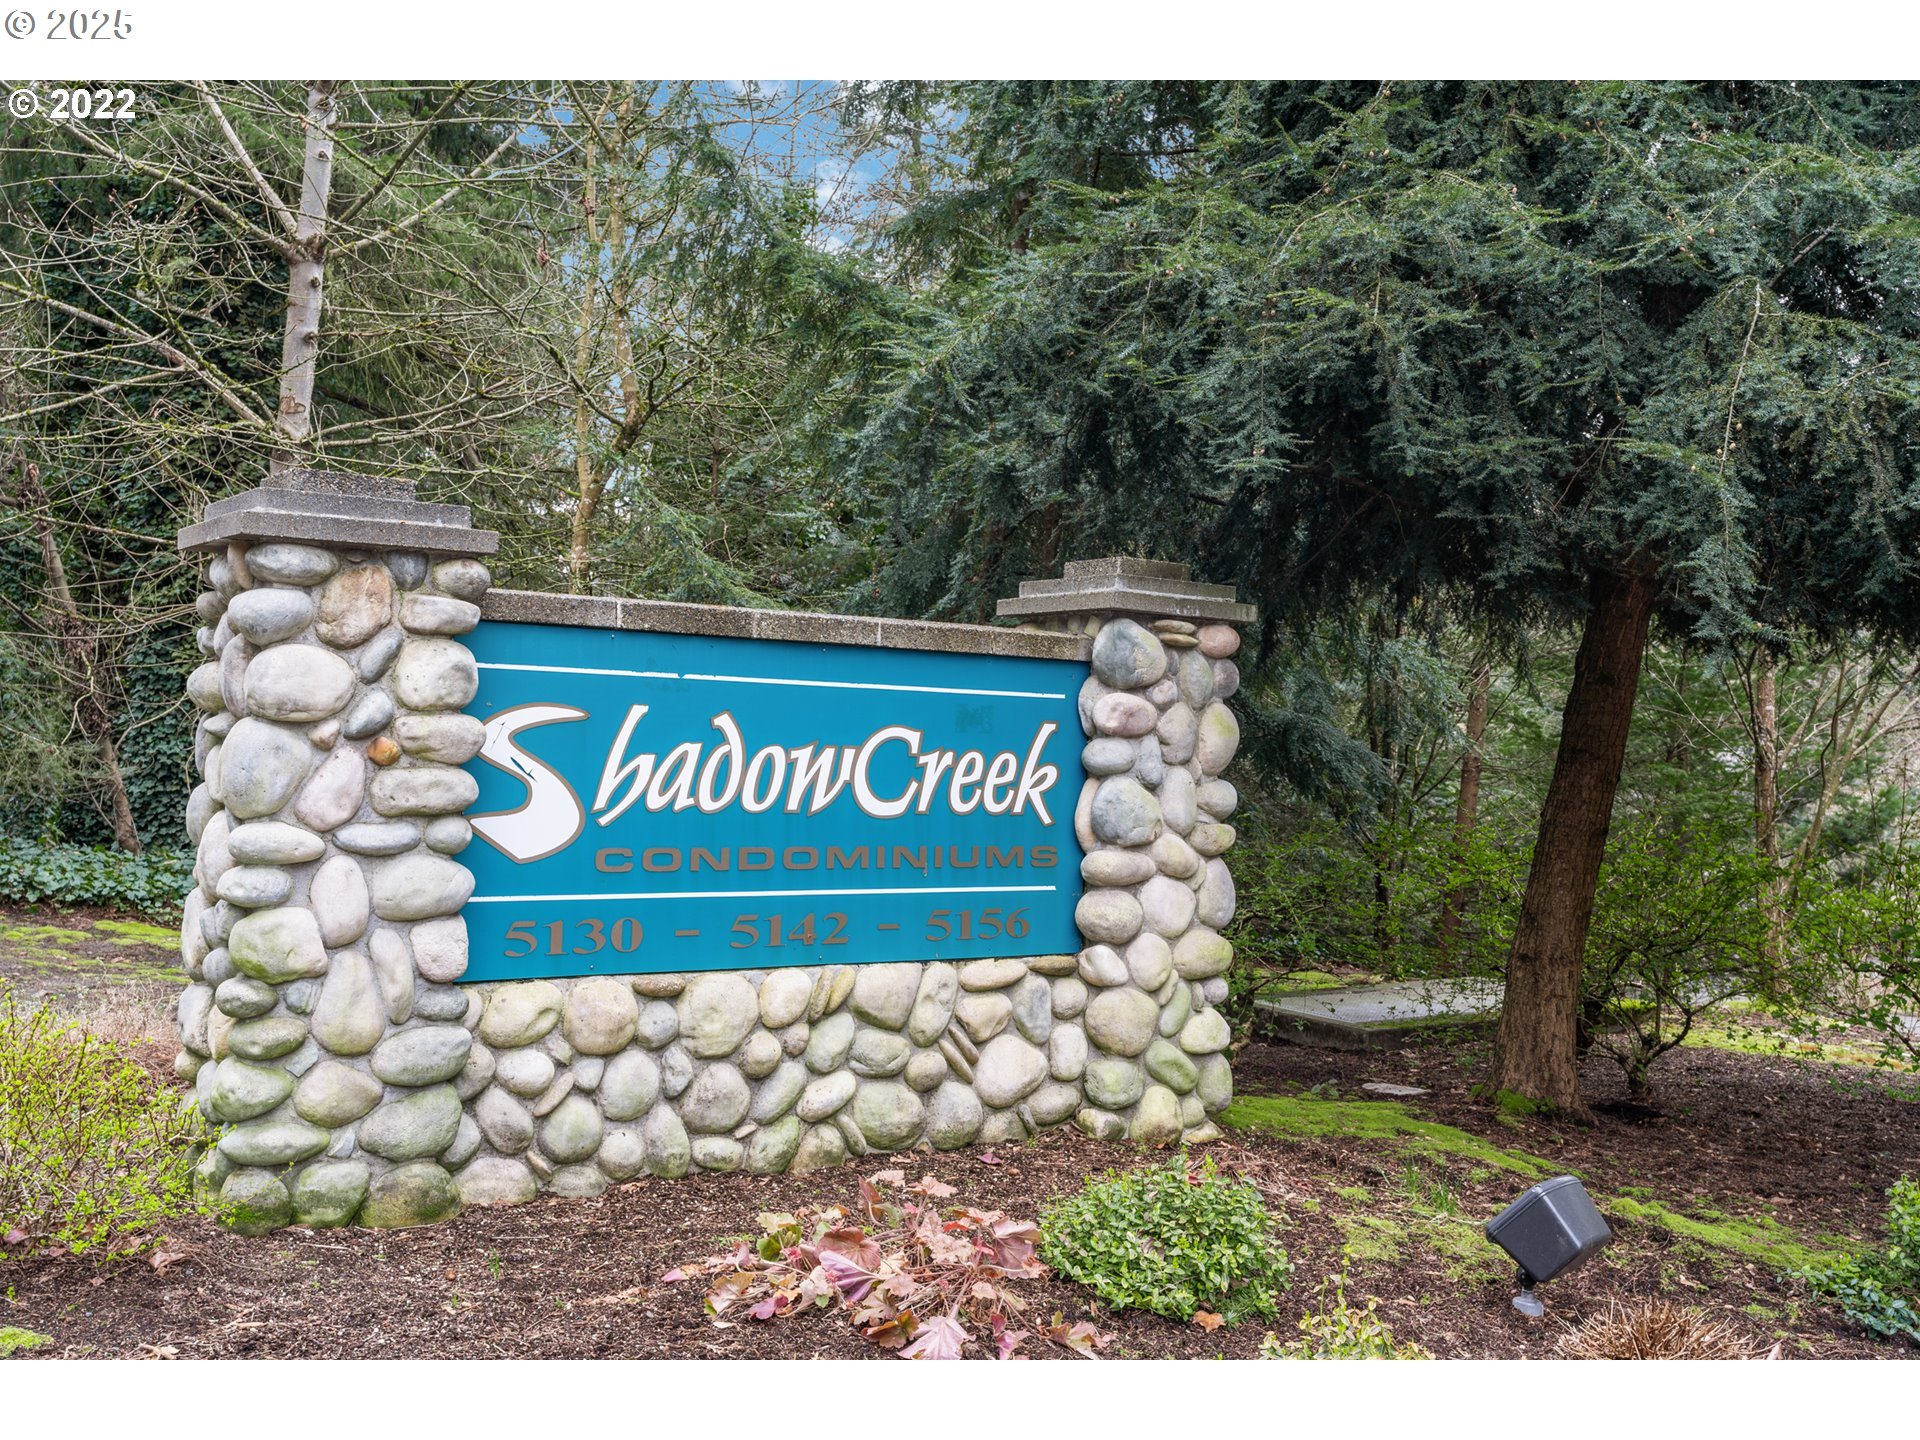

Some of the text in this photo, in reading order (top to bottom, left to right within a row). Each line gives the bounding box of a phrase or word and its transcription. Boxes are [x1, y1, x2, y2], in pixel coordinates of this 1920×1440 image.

[469, 702, 1060, 864] ShadowCreek
[594, 846, 1058, 873] CONDOMINIUMS
[504, 917, 644, 957] 5130
[730, 912, 850, 949] 5142
[926, 908, 1031, 940] 5156
